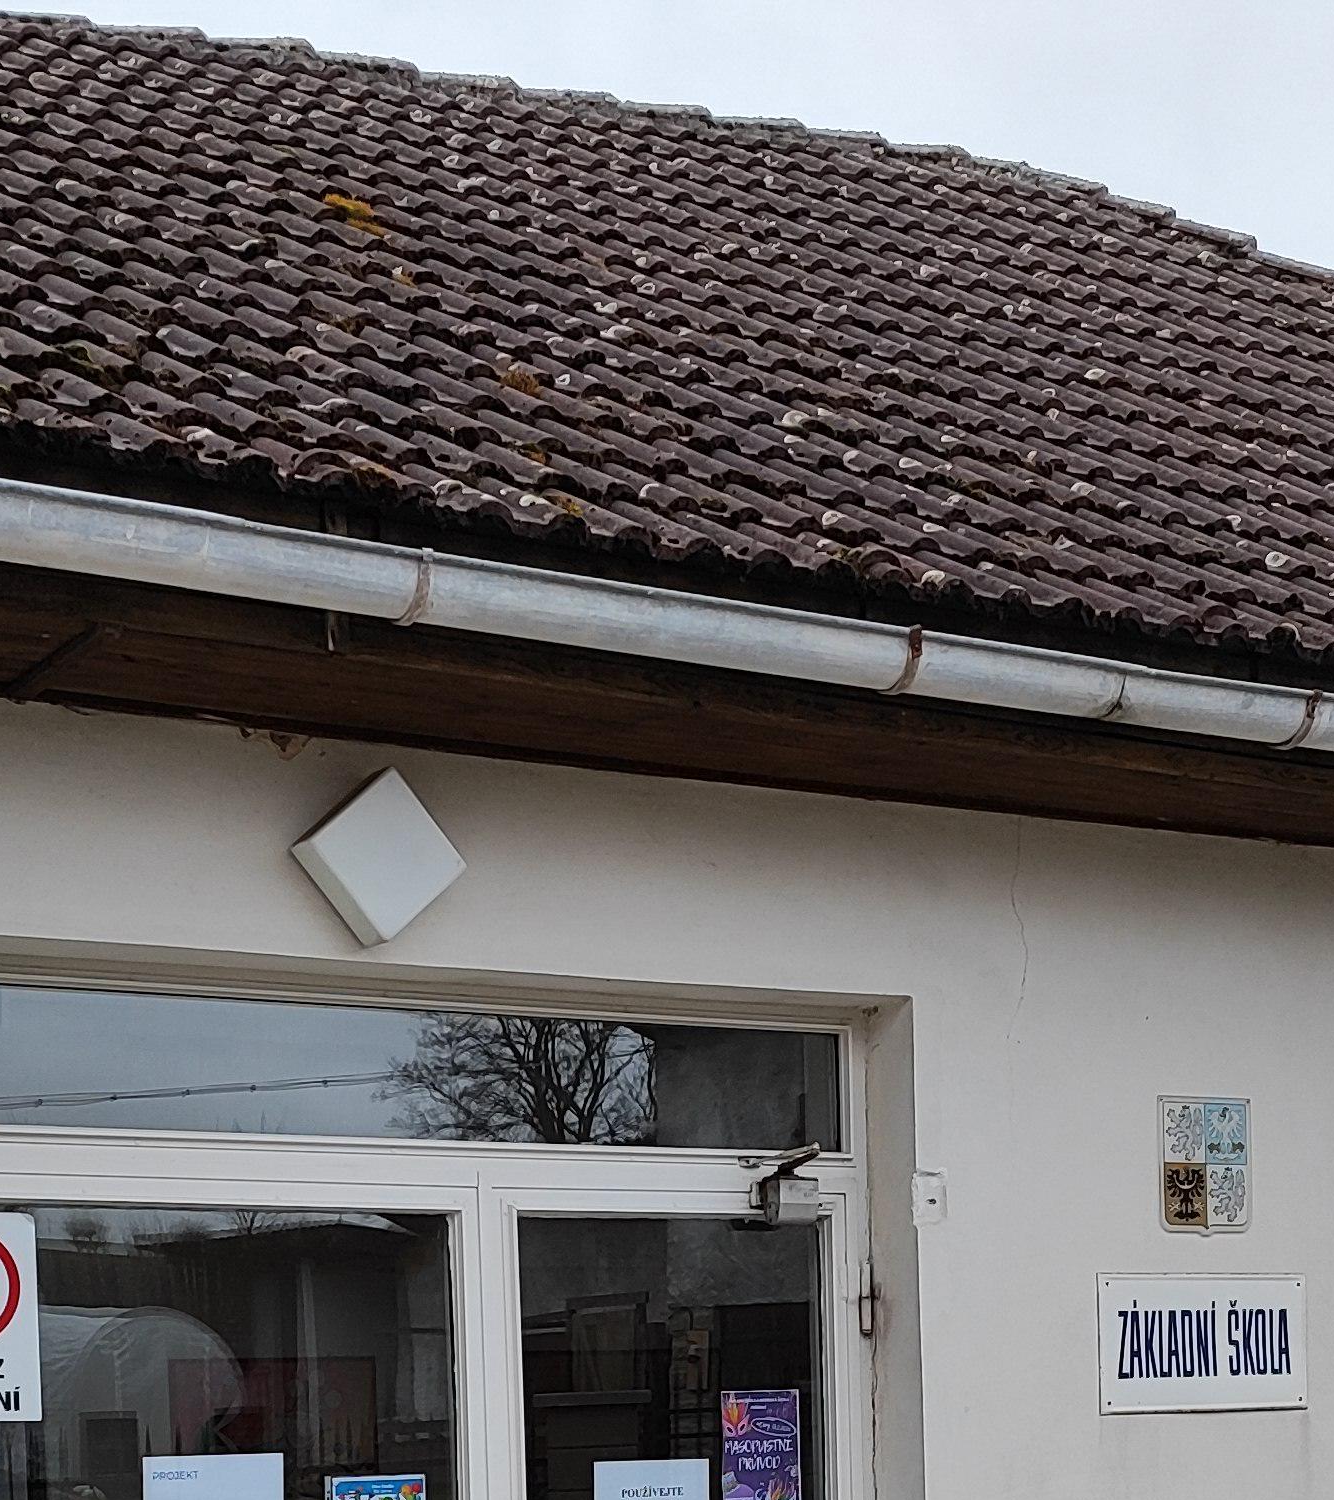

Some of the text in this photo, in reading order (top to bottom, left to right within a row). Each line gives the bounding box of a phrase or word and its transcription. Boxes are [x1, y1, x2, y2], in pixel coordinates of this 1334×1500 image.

[1117, 1298, 1292, 1380] ZÁKLADNÍ ŠKOLA
[739, 1454, 782, 1472] PRŮVOD
[152, 1470, 199, 1481] PROJEKT
[621, 1485, 684, 1498] POUŽÍVEJTE
